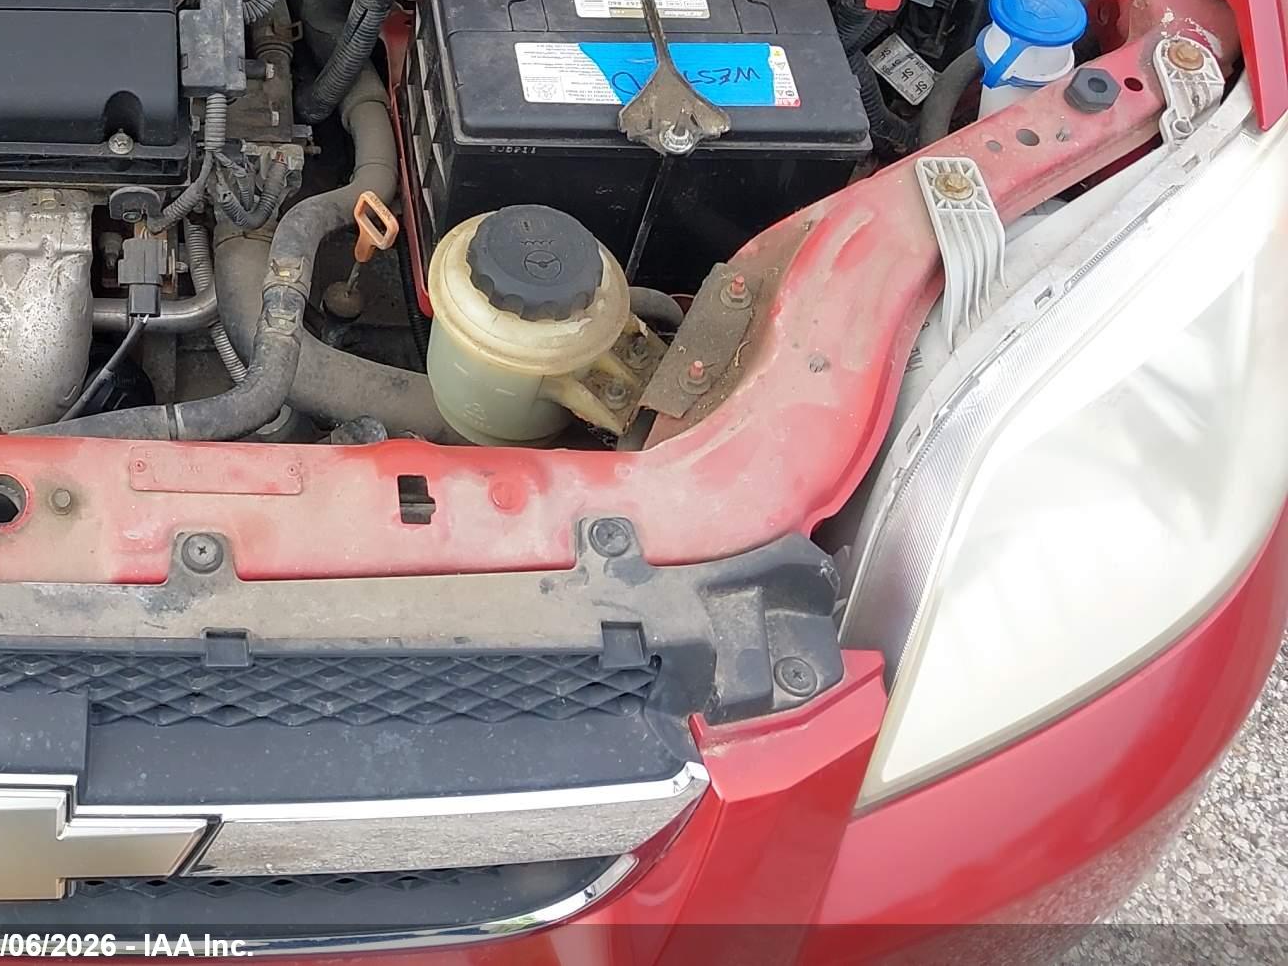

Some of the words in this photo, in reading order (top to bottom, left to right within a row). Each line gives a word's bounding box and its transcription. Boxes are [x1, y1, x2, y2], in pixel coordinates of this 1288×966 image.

[879, 47, 892, 61] SF
[901, 68, 914, 82] SF
[915, 80, 928, 95] SF
